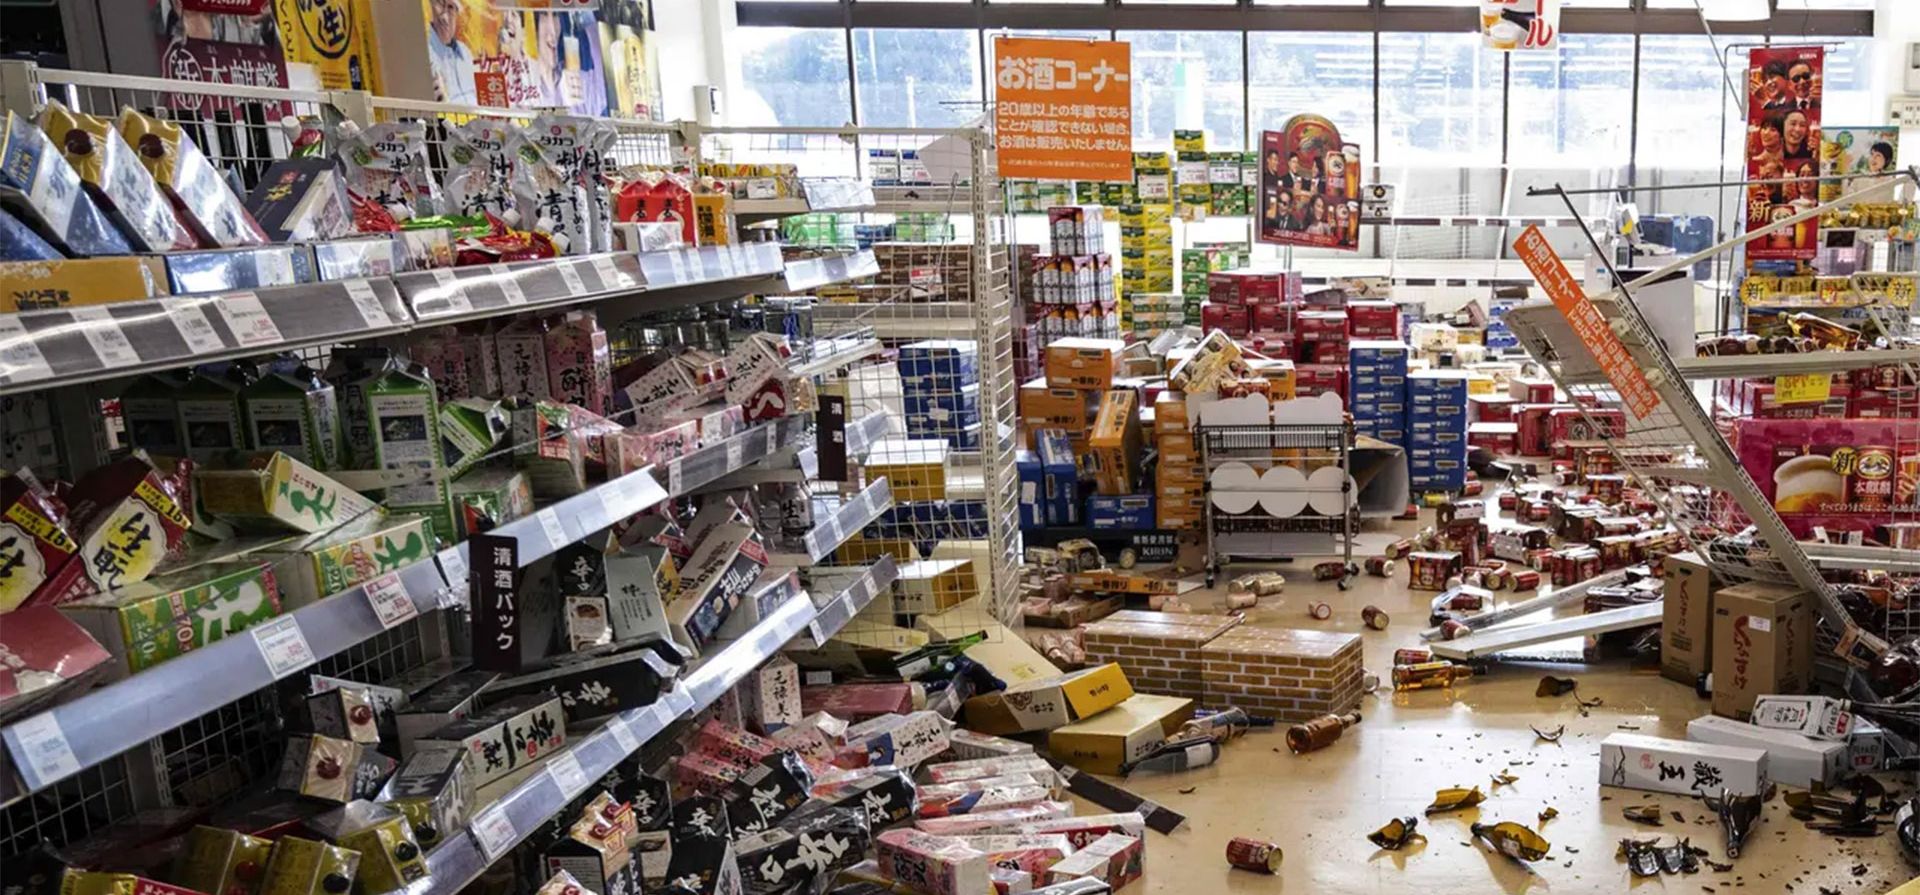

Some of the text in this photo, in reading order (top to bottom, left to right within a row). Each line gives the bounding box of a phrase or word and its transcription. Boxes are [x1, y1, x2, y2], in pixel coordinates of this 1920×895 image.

[998, 55, 1129, 93] お酒コーナー
[999, 101, 1130, 119] 20歳以上の年齢である
[999, 118, 1131, 135] ことが確認できない場合、
[999, 135, 1131, 152] お酒は販売いたしません。
[1749, 201, 1770, 223] 新
[831, 402, 843, 443] 清酒
[1836, 451, 1856, 473] 新
[1855, 481, 1891, 495] 本麒麟
[1142, 546, 1173, 556] KIRIN
[494, 546, 515, 651] 清酒パック
[1658, 761, 1723, 791] 蔵王
[760, 831, 850, 884] 辛口
